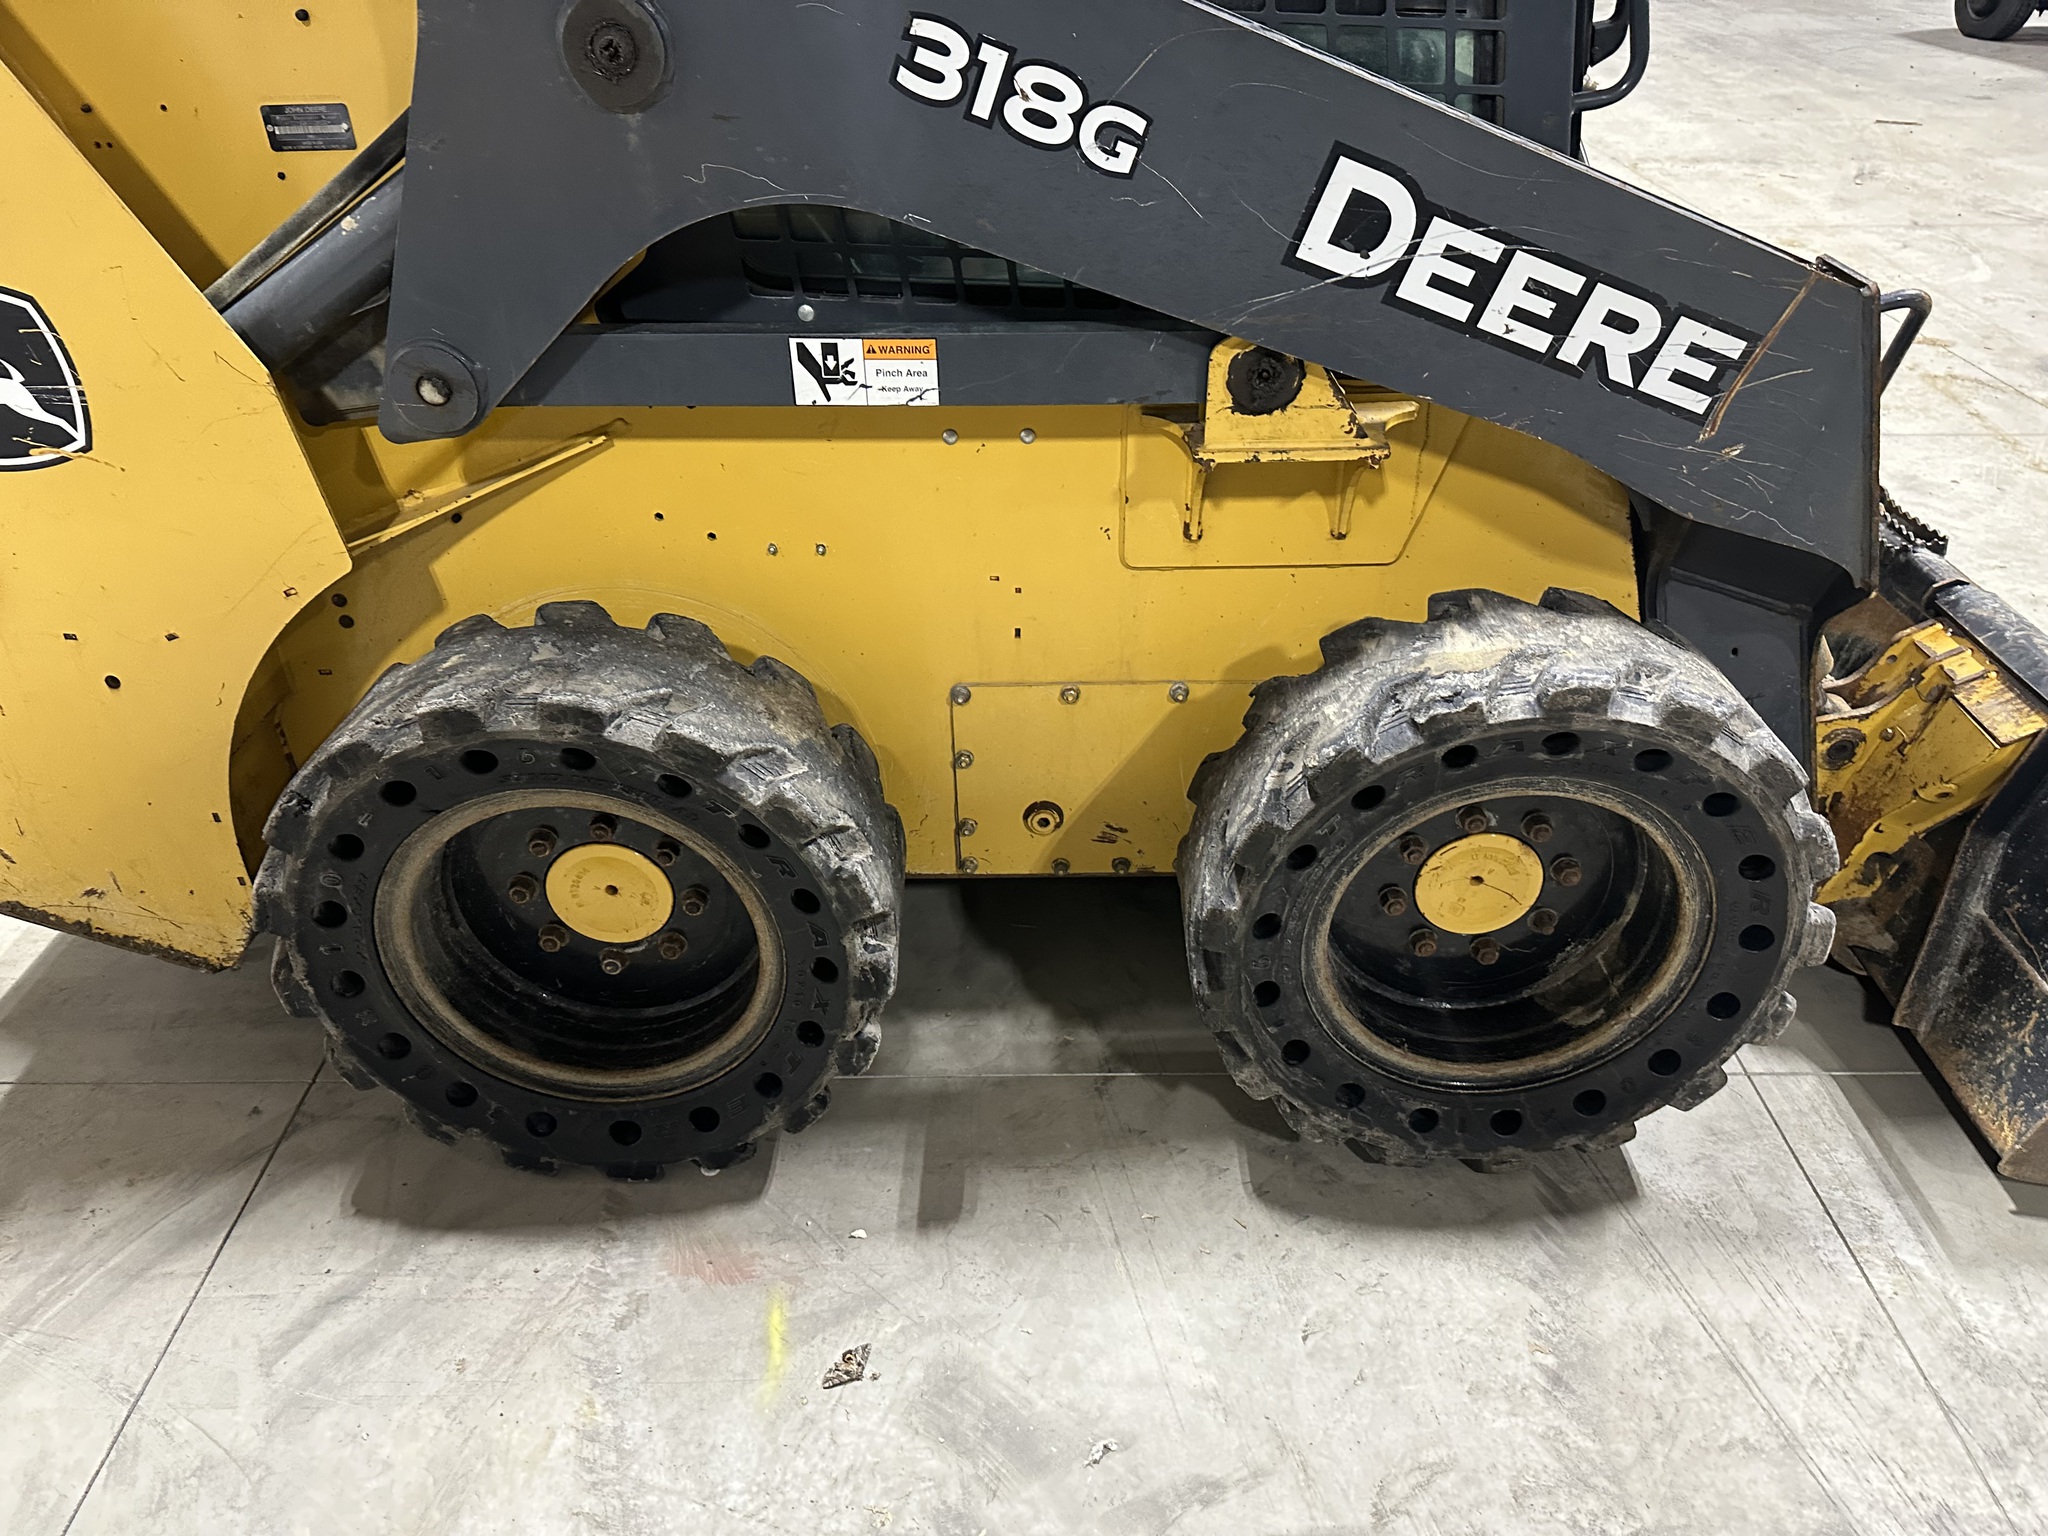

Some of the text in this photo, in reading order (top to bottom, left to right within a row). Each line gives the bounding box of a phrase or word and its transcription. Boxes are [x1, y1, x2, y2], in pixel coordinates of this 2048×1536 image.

[896, 18, 1149, 174] 318G
[1295, 155, 1749, 415] DEERE
[877, 345, 931, 354] WARNING
[875, 368, 928, 377] Pinch Area
[881, 385, 924, 394] Keep Away
